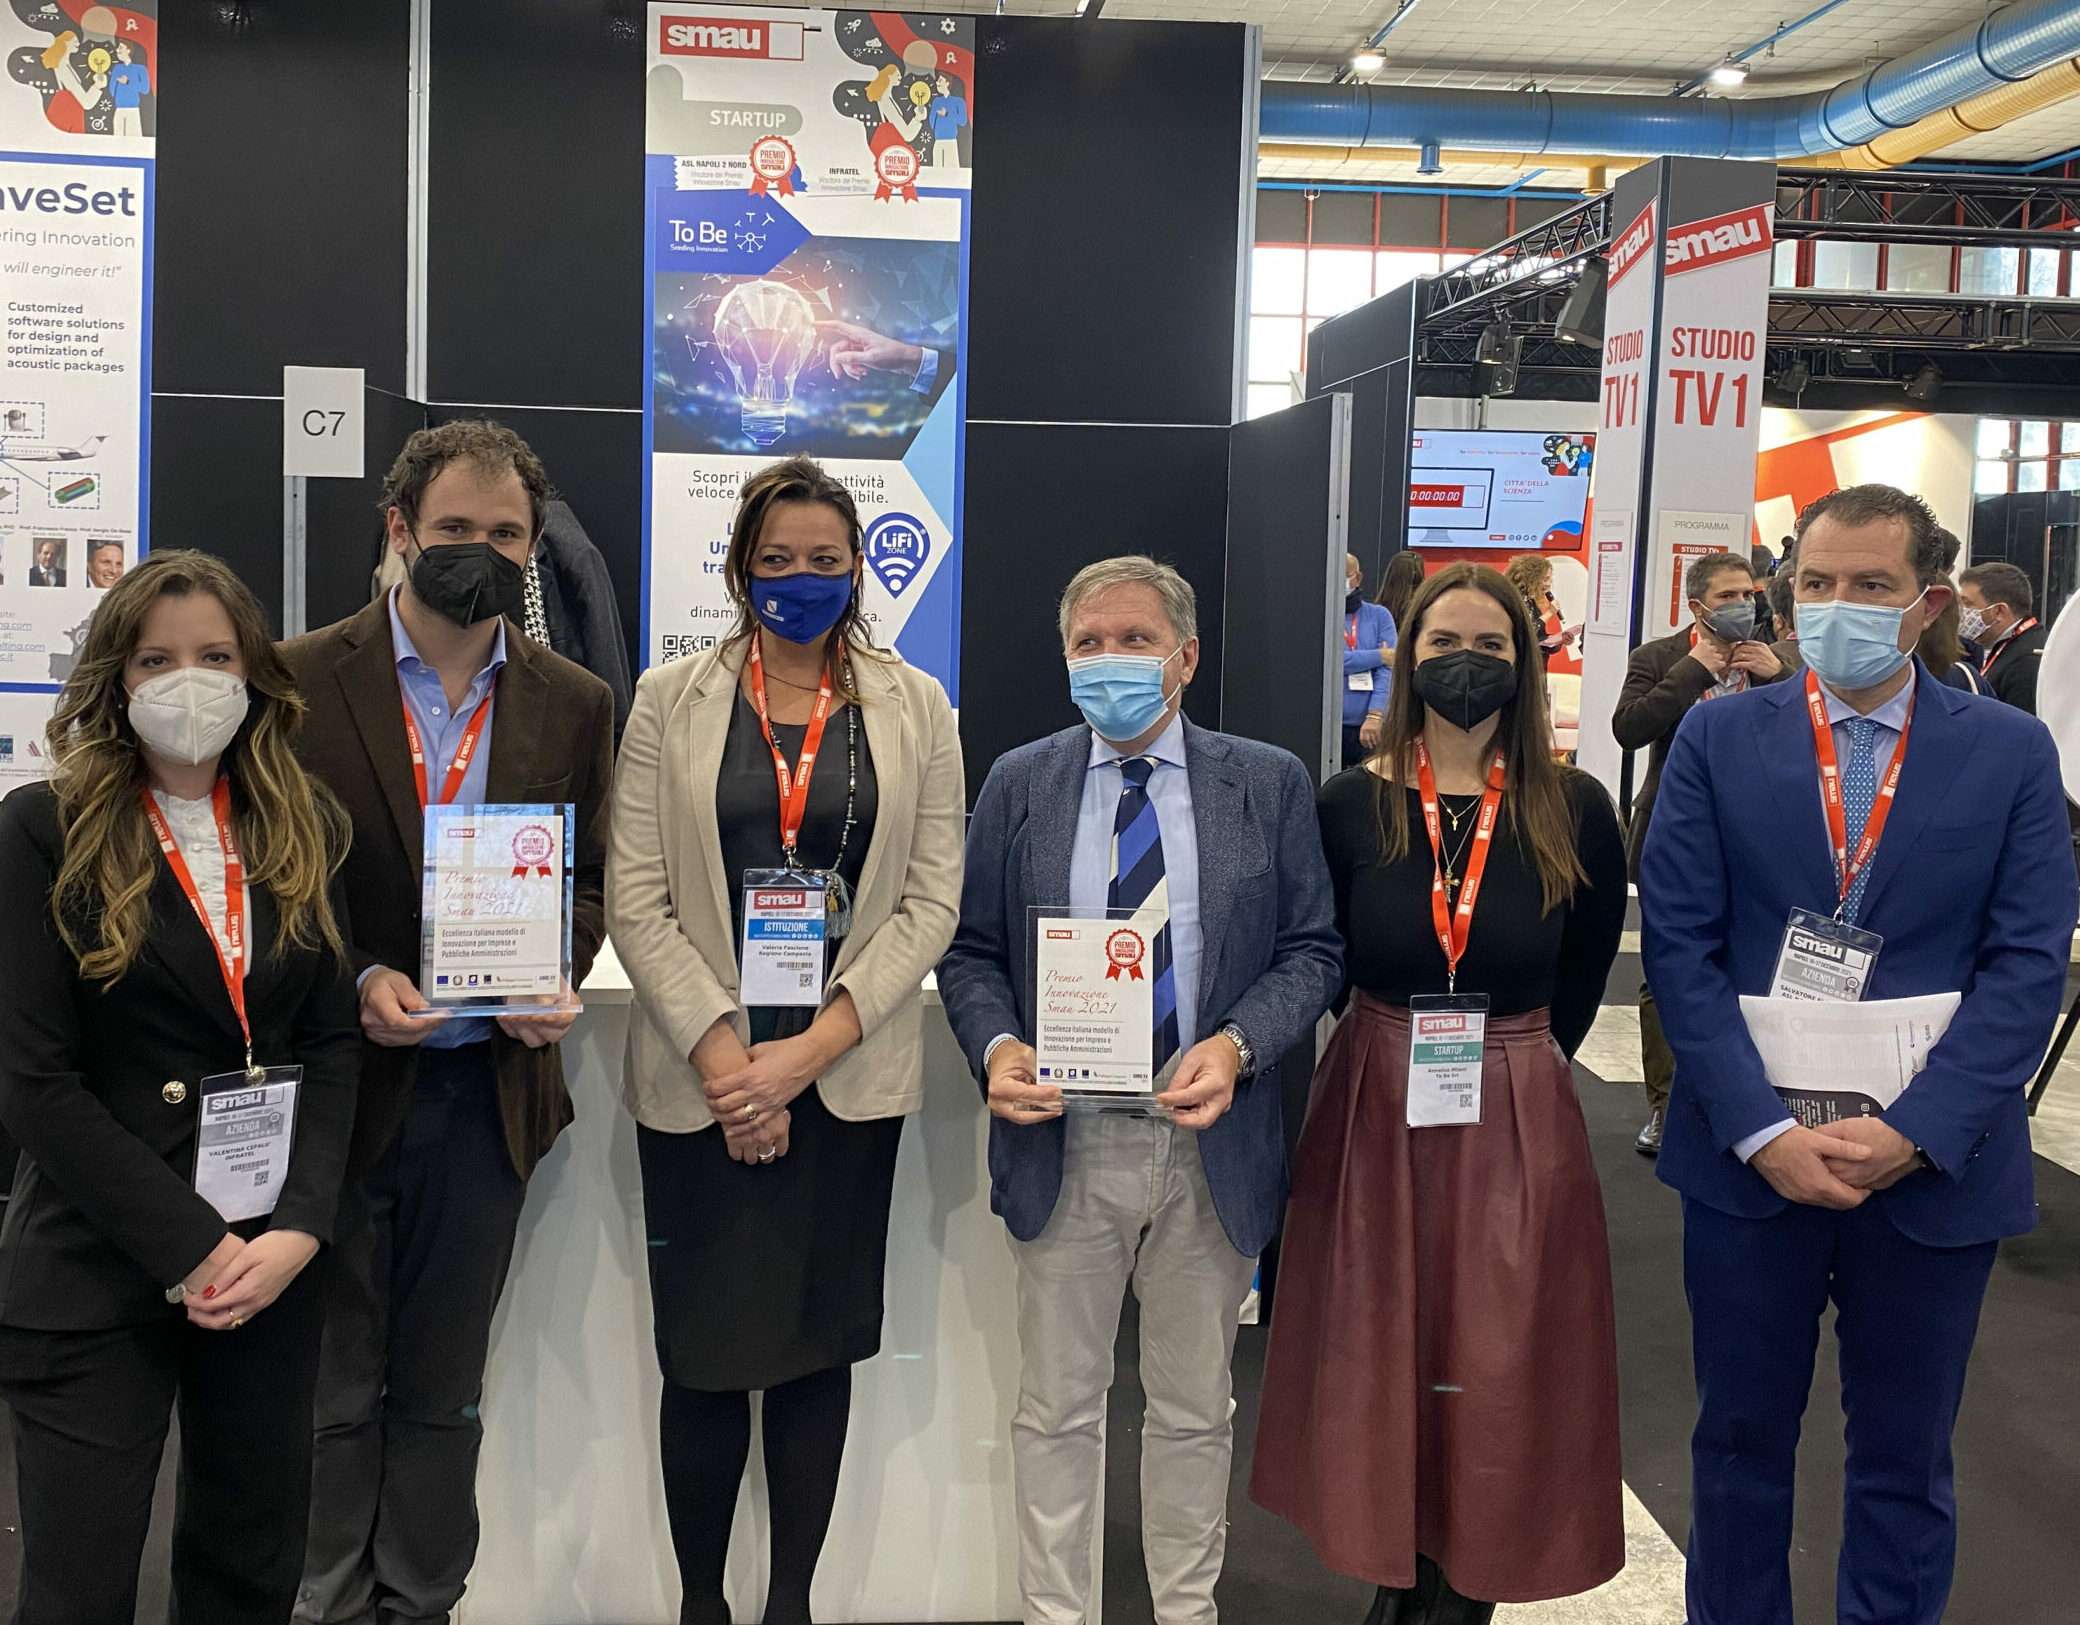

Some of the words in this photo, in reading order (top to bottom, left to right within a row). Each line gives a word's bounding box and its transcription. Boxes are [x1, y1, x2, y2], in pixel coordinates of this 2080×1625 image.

[667, 24, 761, 50] smau
[710, 110, 786, 128] STARTUP
[760, 150, 785, 160] PREMIO
[885, 156, 910, 165] PREMIO
[696, 160, 720, 168] NAPOLI
[728, 161, 747, 169] NORD
[0, 183, 136, 216] veSet
[0, 228, 36, 246] ring
[43, 231, 135, 248] Innovation
[669, 220, 695, 242] To
[700, 221, 727, 244] Be
[1666, 218, 1761, 265] smau
[4, 262, 29, 274] will
[32, 264, 98, 278] engineer
[8, 302, 83, 314] Customized
[8, 316, 63, 327] software
[67, 319, 125, 330] solutions
[8, 330, 25, 340] for
[29, 331, 71, 343] design
[74, 333, 98, 343] and
[1671, 326, 1756, 361] STUDIO
[8, 344, 87, 356] optimization
[91, 347, 104, 357] of
[1607, 329, 1644, 365] STUDIO
[8, 359, 60, 370] acoustic
[64, 361, 124, 373] packages
[302, 409, 346, 436] C7
[693, 470, 739, 486] Scopri
[836, 474, 884, 489] ettività
[688, 487, 740, 500] veloce,
[853, 491, 889, 504] ibile.
[1674, 521, 1729, 530] PROGRAMMA
[882, 532, 912, 548] LiFi
[690, 606, 738, 618] dinami
[1813, 703, 1825, 726] smau
[460, 734, 474, 759] smau
[1828, 778, 1838, 804] smau
[1482, 805, 1494, 830] smau
[1464, 879, 1476, 903] smau
[758, 894, 802, 906] smau
[230, 915, 240, 947] smau
[442, 929, 472, 937] Eccellenza
[474, 928, 495, 937] italiana
[496, 928, 519, 936] modello
[764, 921, 808, 931] ISTITUZIONE
[1114, 941, 1136, 949] PREMIO
[1792, 935, 1842, 959] smau
[1045, 969, 1083, 982] Premio
[1801, 967, 1835, 986] AZIENDA
[1044, 985, 1108, 1001] Innovazione
[1780, 984, 1816, 1000] SALVATORE
[1043, 1001, 1073, 1013] Smau
[1077, 1001, 1117, 1014] 2021
[1044, 1024, 1071, 1033] Eccellenza
[1072, 1025, 1092, 1033] italiana
[1093, 1025, 1113, 1034] modello
[1423, 1017, 1463, 1030] smau
[1434, 1045, 1464, 1056] STARTUP
[211, 1091, 262, 1110] smau
[226, 1120, 260, 1136] AZIENDA
